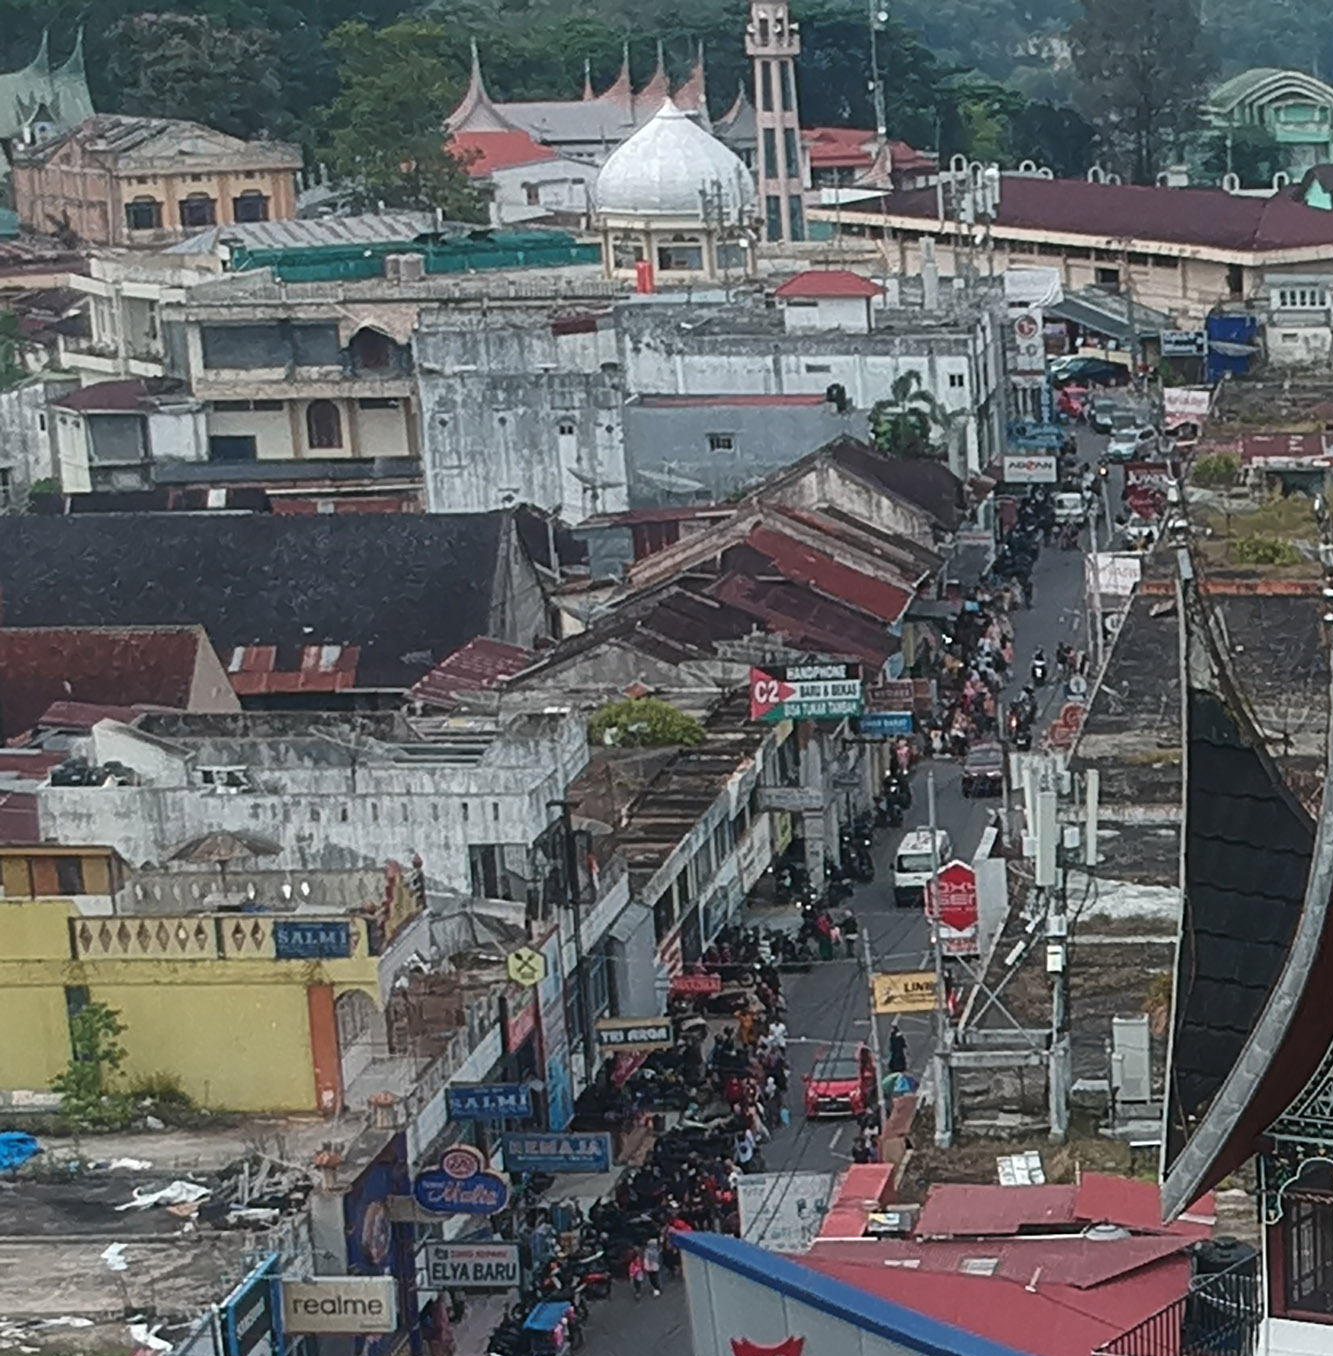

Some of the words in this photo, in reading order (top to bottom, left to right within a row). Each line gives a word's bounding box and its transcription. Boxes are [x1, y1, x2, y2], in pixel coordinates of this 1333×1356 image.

[754, 681, 780, 703] C2
[278, 930, 347, 945] SALMI
[432, 1262, 470, 1281] ELYA
[473, 1262, 517, 1281] BARU
[292, 1296, 383, 1316] realme
